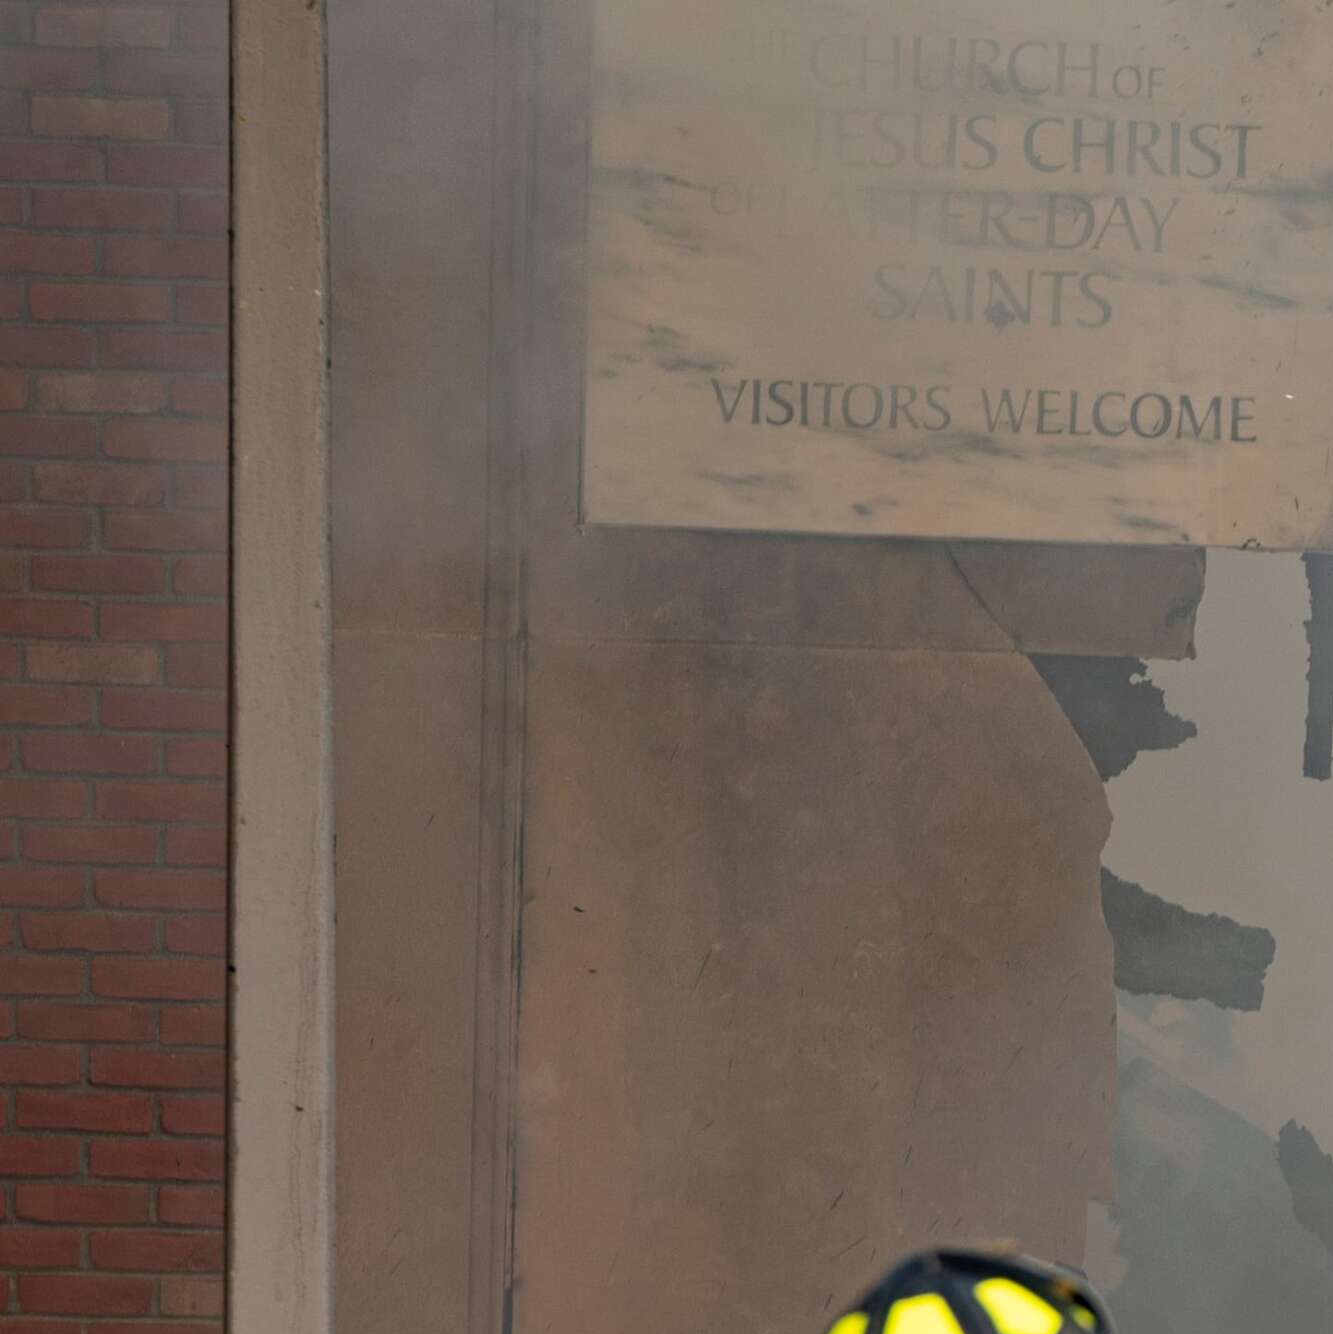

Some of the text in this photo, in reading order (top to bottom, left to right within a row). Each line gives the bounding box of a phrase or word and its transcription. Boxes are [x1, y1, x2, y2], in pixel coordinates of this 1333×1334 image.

[809, 32, 1102, 98] CHURCH
[1110, 62, 1167, 100] OF
[802, 109, 1264, 182] JESUS CHRIST
[870, 262, 1114, 330] SAINTS
[709, 376, 1260, 444] VISITORS WELCOME
